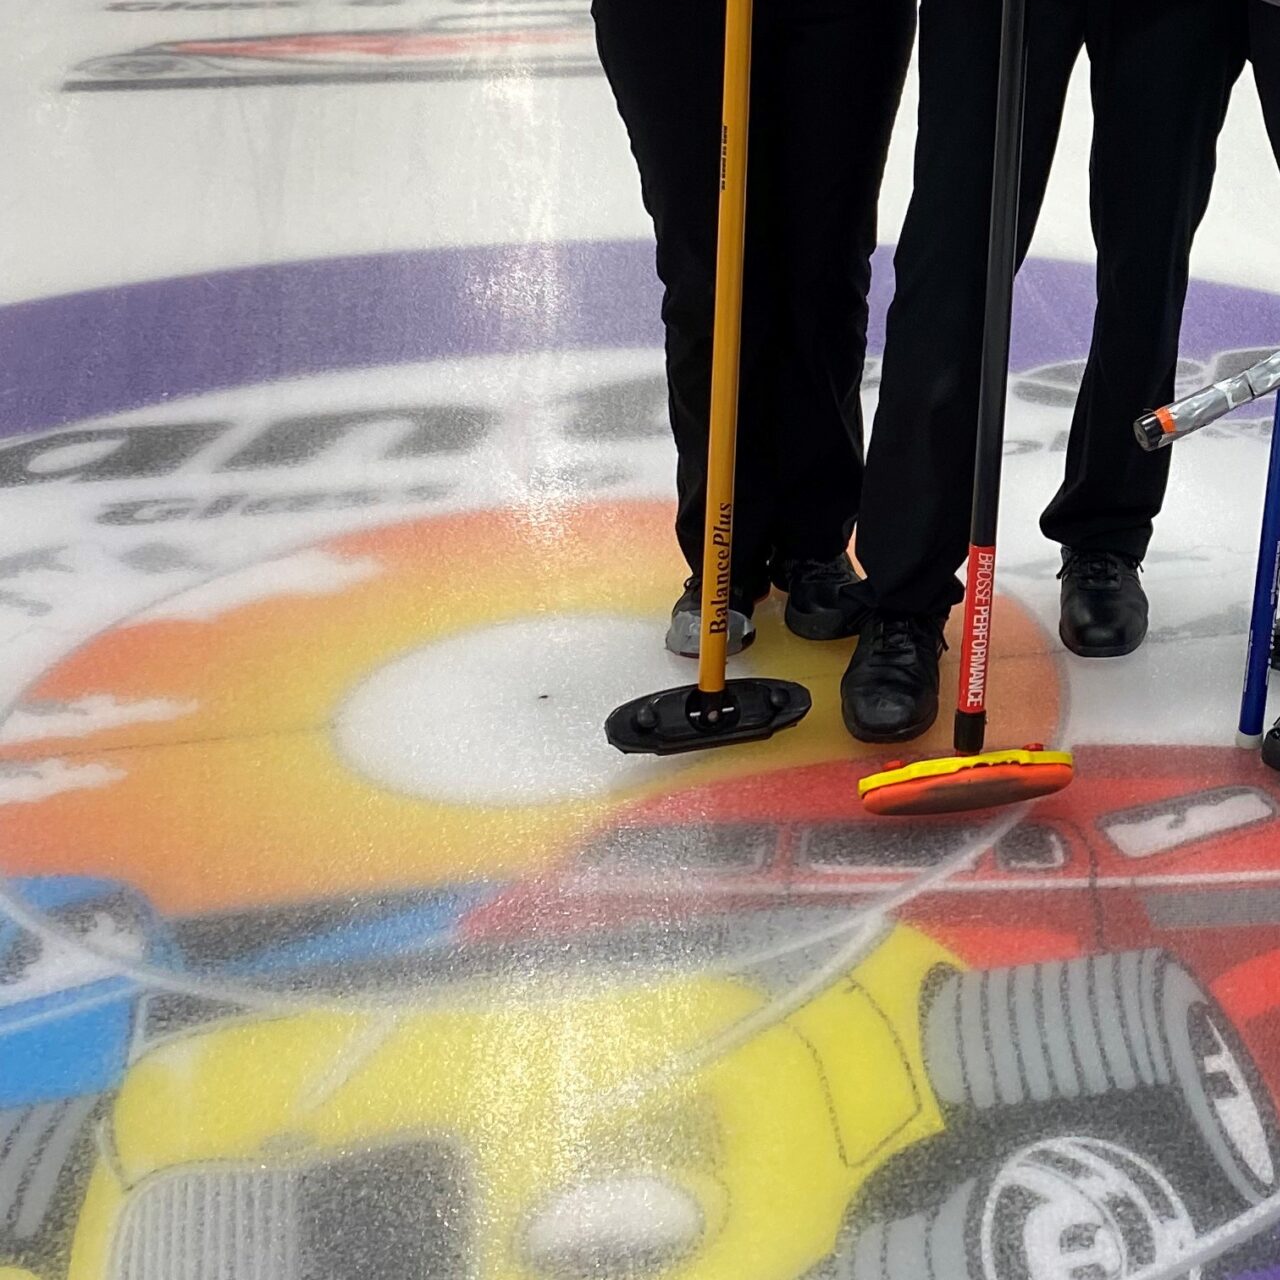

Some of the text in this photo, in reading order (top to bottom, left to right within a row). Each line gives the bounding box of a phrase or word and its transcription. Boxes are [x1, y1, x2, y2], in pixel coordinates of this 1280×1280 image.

[709, 502, 734, 636] BalancePlus
[966, 552, 994, 708] BROSSE PERFORMANCE
